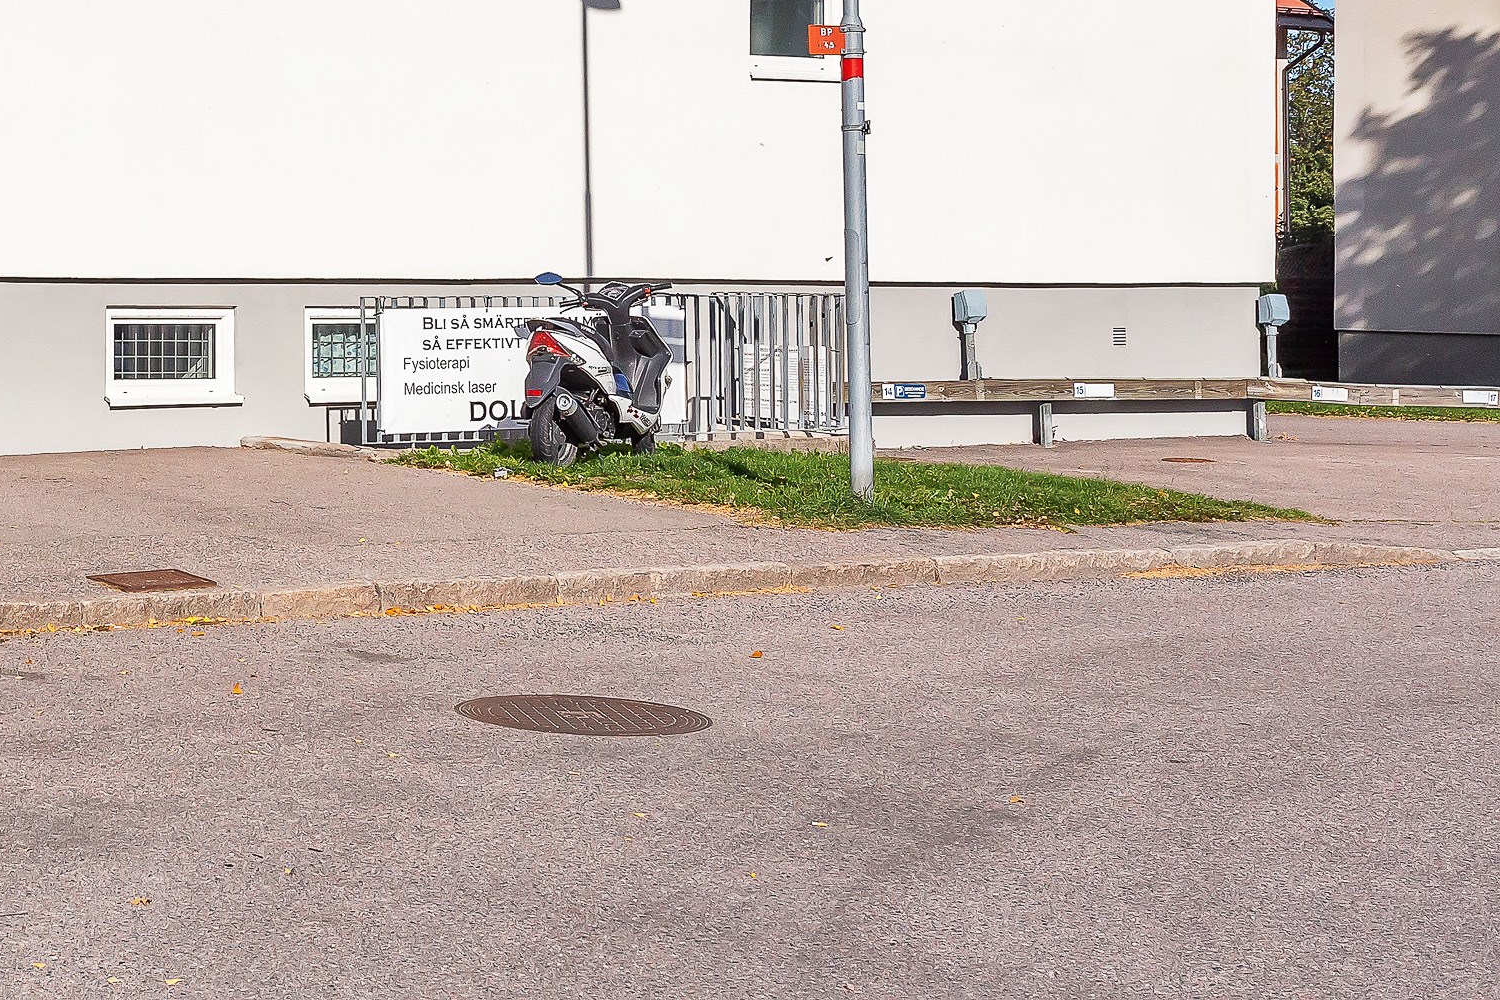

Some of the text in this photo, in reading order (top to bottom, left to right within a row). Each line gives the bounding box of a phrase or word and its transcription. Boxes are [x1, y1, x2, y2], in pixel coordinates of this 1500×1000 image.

[820, 27, 833, 37] BP
[450, 314, 470, 330] SÅ
[473, 314, 543, 330] SMÄRTF
[422, 335, 523, 351] SÅ EFFEKTIVT
[403, 356, 470, 374] Fysioterapi
[404, 380, 497, 396] Medicinsk laser
[469, 400, 522, 422] DOL
